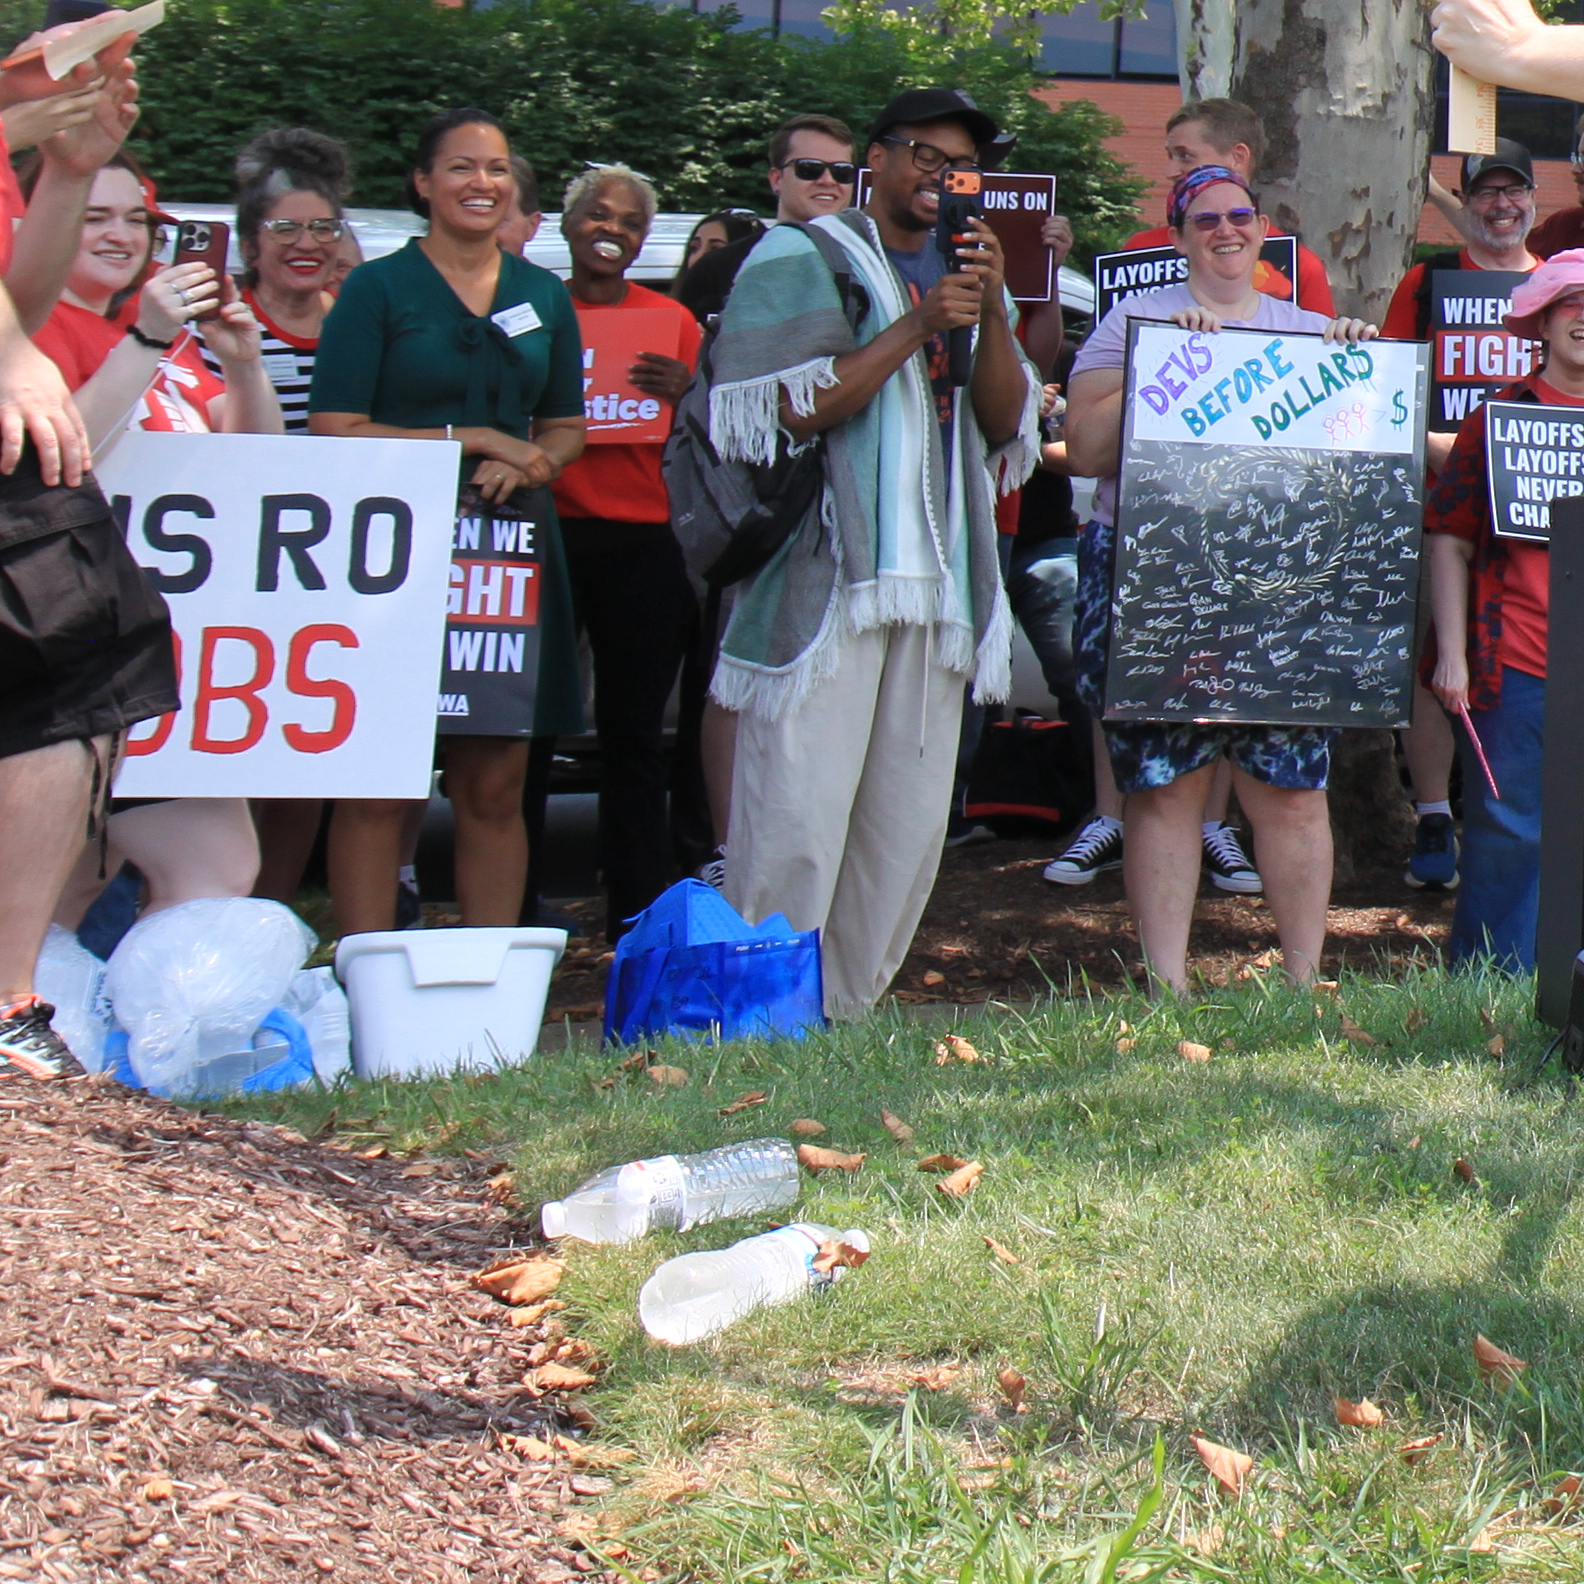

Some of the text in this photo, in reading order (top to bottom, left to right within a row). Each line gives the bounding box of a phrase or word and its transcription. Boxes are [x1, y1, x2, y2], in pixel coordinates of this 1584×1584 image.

[984, 190, 1048, 211] UNS ON
[1138, 332, 1213, 416] DEVS
[1180, 337, 1295, 438] BEFORE
[1509, 502, 1550, 528] CHA
[493, 519, 536, 554] WE
[449, 630, 525, 674] WIN
